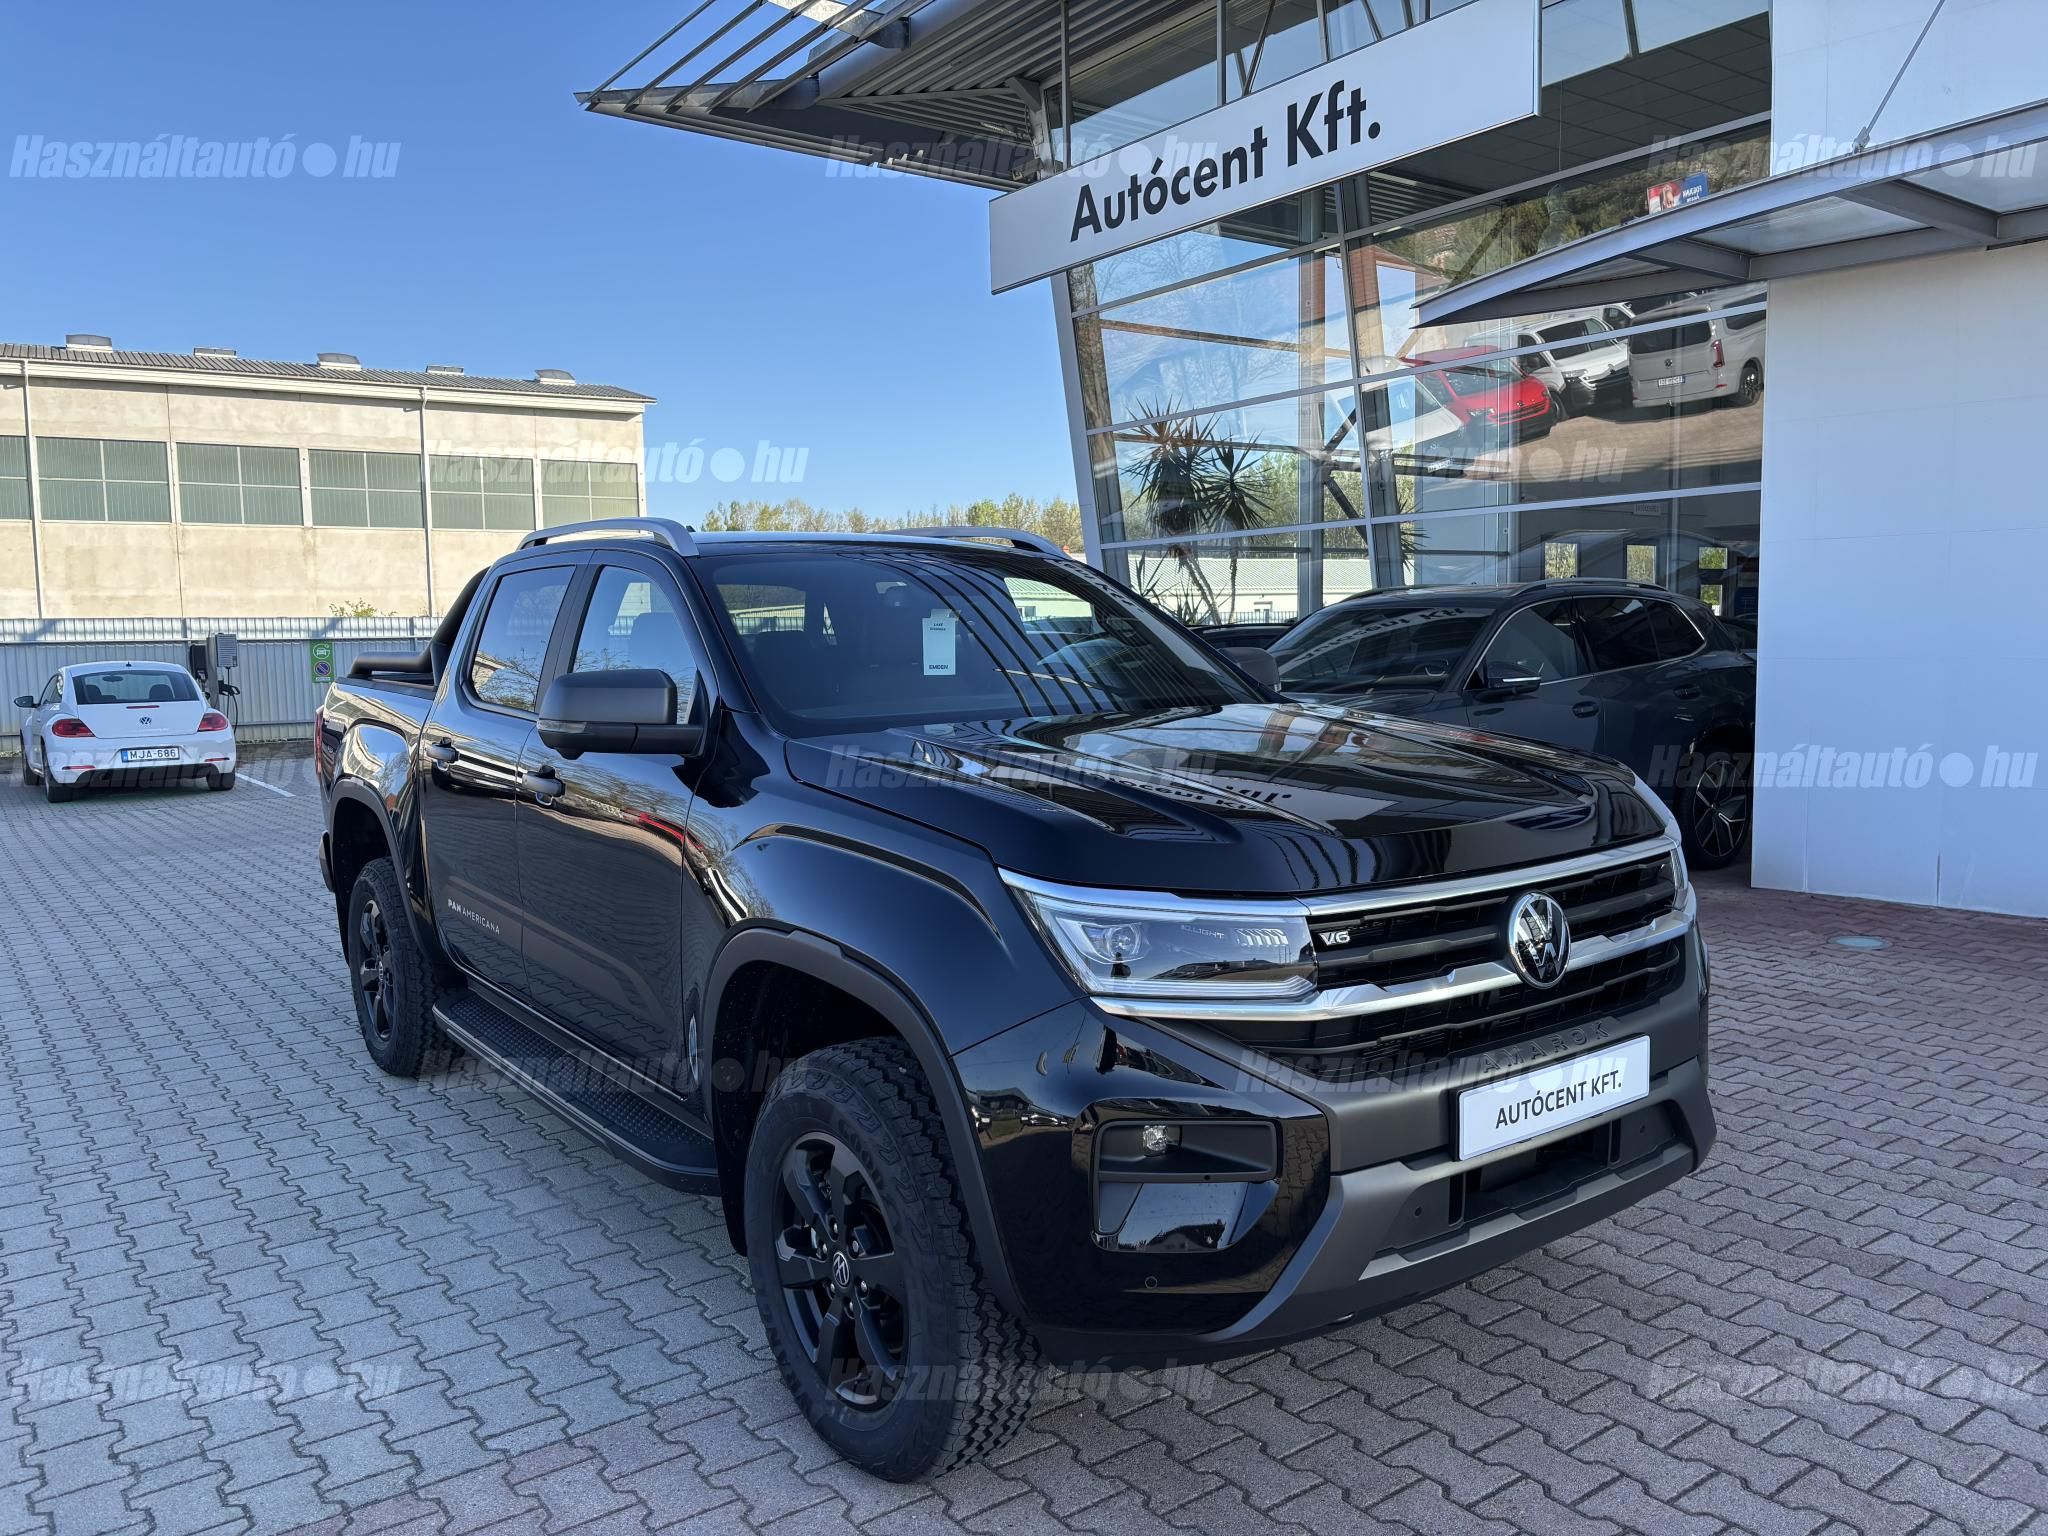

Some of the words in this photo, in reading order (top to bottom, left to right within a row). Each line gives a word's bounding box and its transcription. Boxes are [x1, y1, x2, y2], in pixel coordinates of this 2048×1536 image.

[1070, 127, 1268, 242] Autócent
[1286, 80, 1380, 166] Kft.
[130, 749, 177, 759] MJA-686
[462, 907, 500, 935] AMERICANA
[1319, 931, 1351, 946] V6
[1482, 1021, 1609, 1073] AMAROK
[1496, 1080, 1586, 1129] AUTÓCENT
[1591, 1070, 1622, 1096] KFT.
